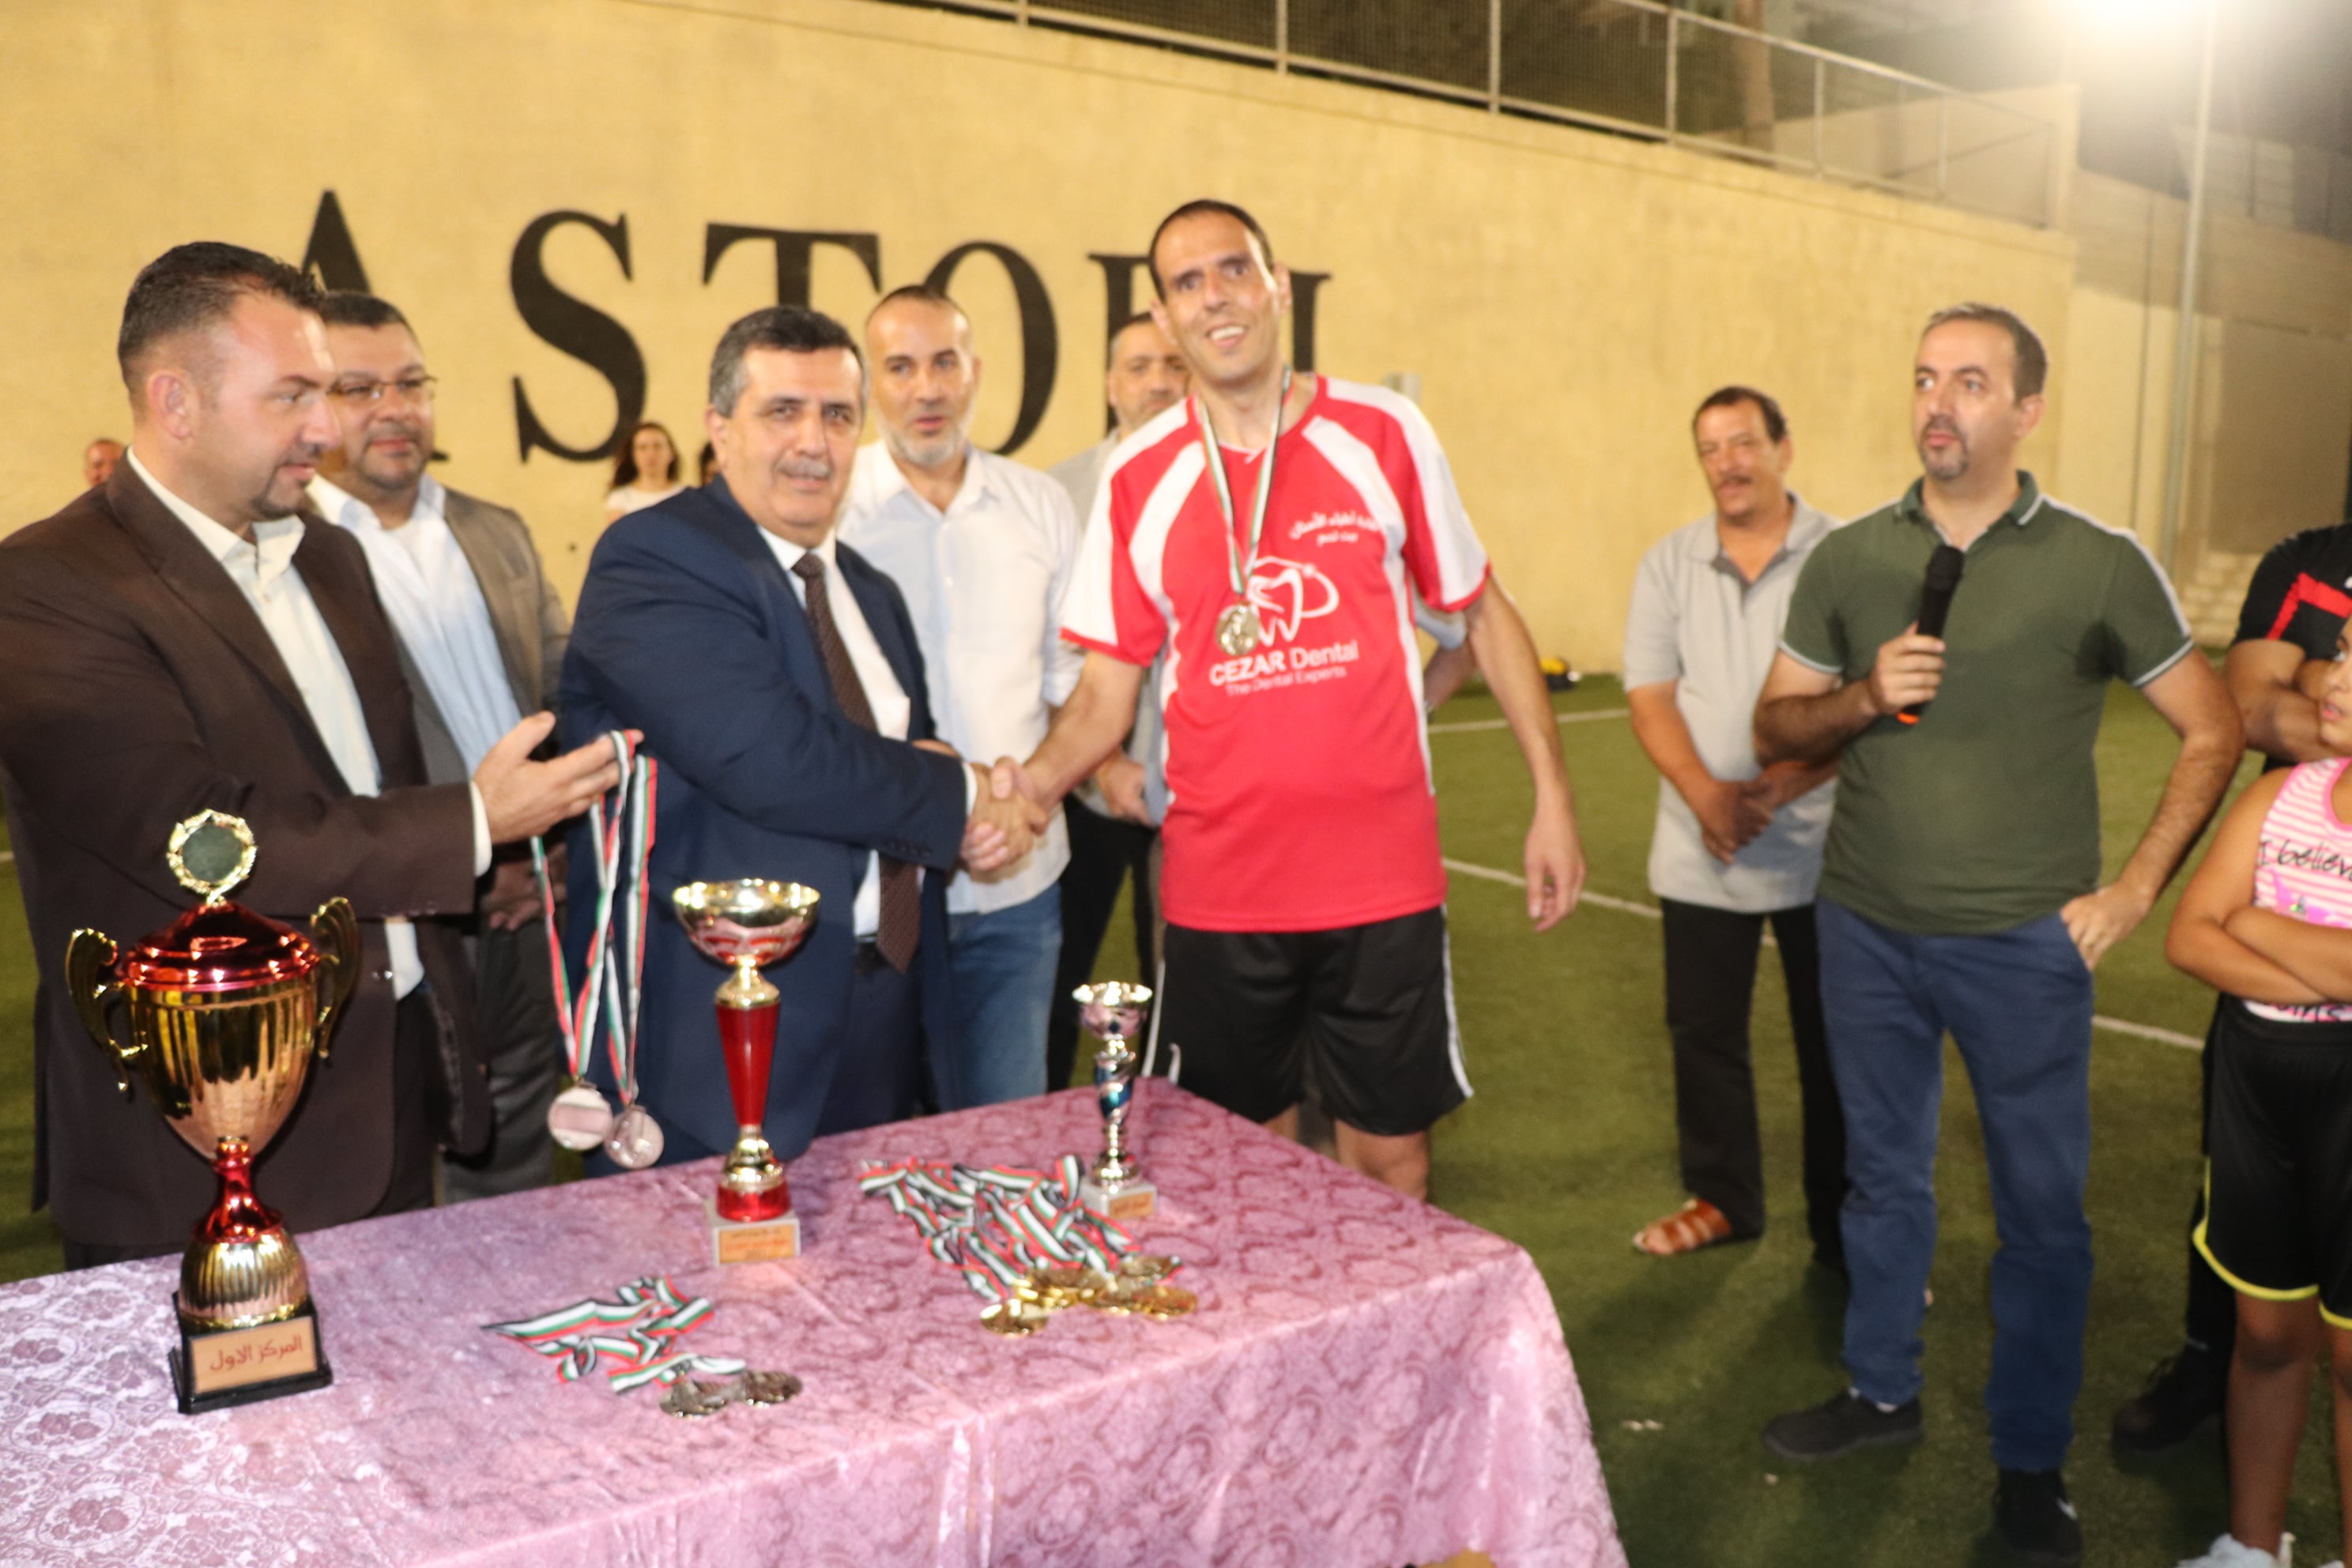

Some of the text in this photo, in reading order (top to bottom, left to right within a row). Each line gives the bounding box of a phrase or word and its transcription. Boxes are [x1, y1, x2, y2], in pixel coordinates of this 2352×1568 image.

[1208, 638, 1360, 687] CEZAR Dental
[209, 1333, 303, 1371] المركز الاول
